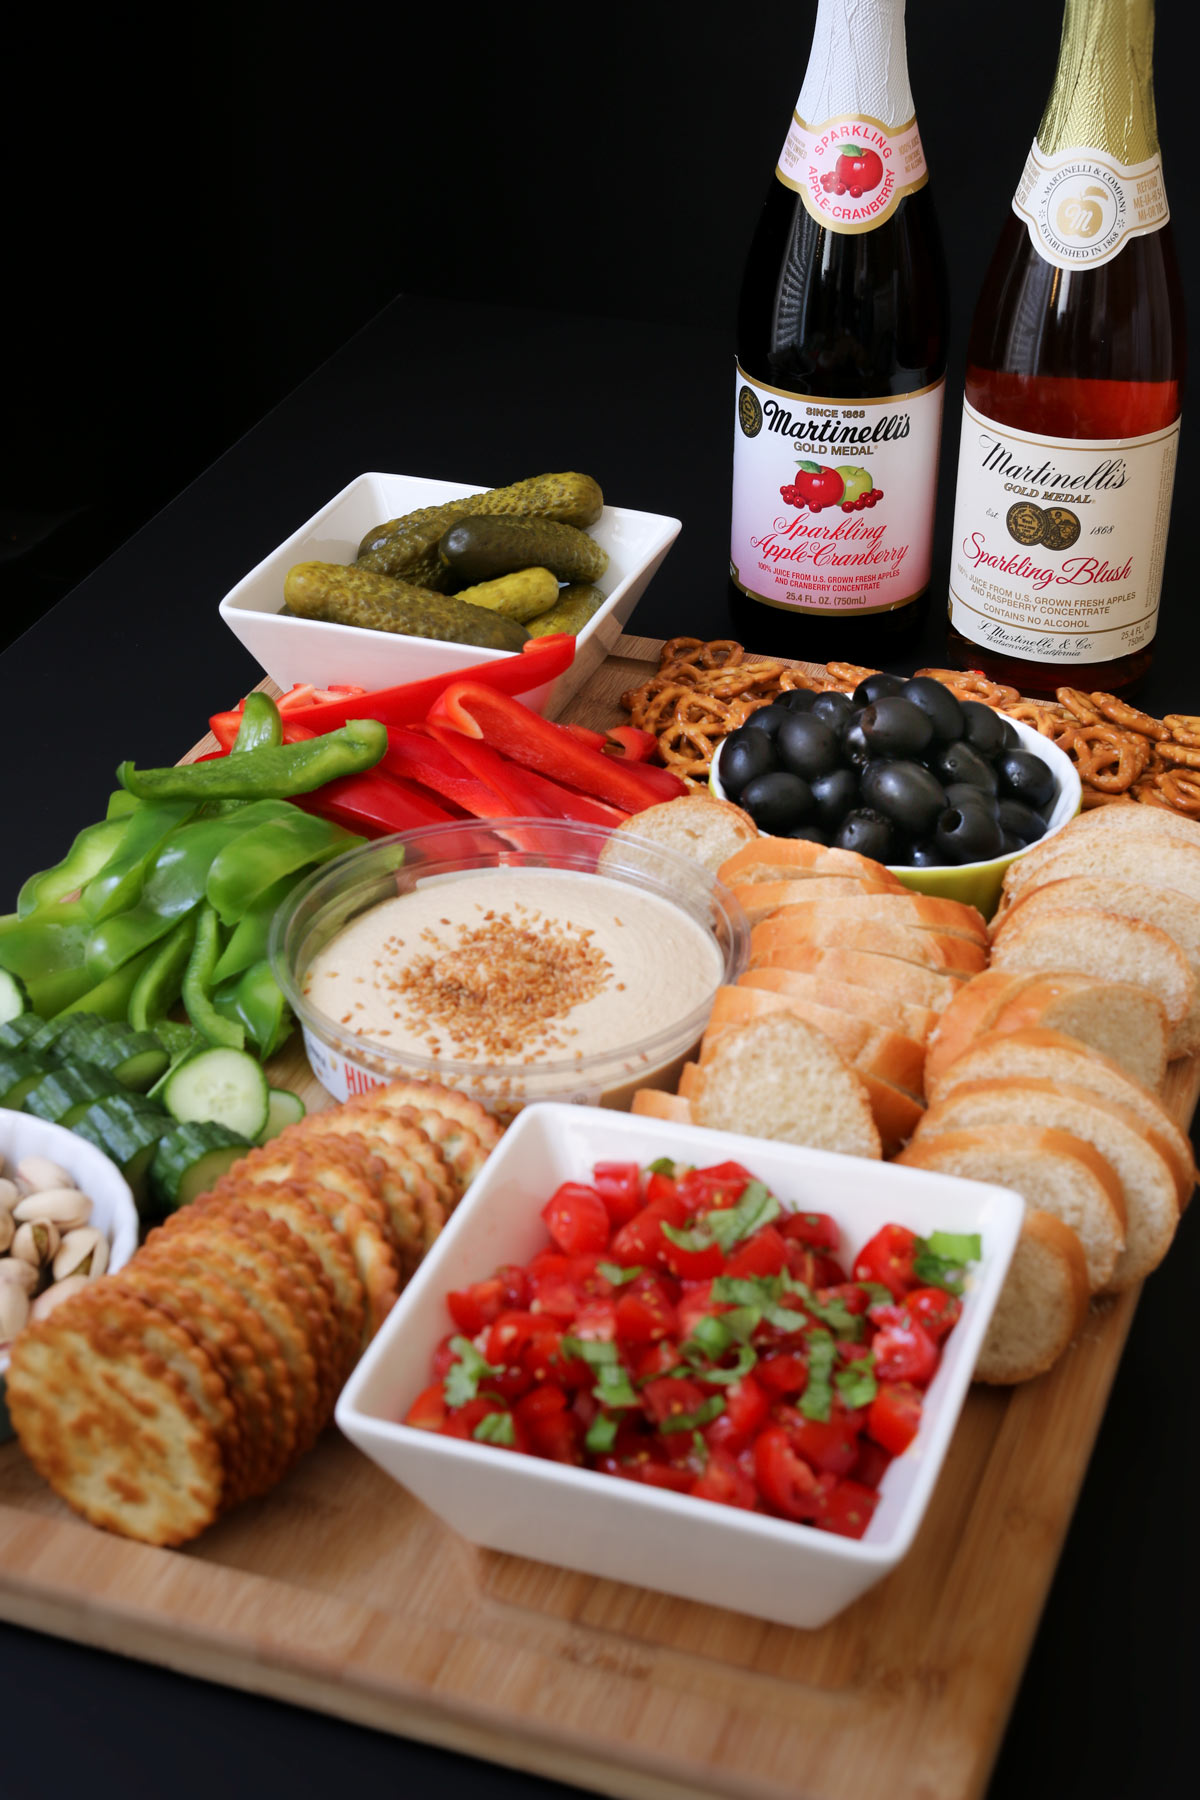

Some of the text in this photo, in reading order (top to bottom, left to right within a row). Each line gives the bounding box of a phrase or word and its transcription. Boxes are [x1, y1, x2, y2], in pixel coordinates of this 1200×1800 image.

[814, 125, 892, 159] SPARKLING
[808, 166, 896, 220] APPLE-CRANBERRY
[1044, 165, 1091, 196] MARTINELLI
[1094, 167, 1101, 175] &
[1103, 172, 1126, 214] COMPANY
[1040, 223, 1119, 258] ESTABLISHED IN 1868
[764, 400, 910, 444] Martinelli's
[806, 407, 866, 418] SINCE 1868
[794, 442, 874, 456] GOLD MEDAL
[979, 434, 1131, 490] Martinelli's
[1004, 482, 1040, 498] GOLD
[773, 512, 887, 548] Sparkling
[1090, 525, 1115, 536] 1868
[750, 534, 910, 570] Apple-Cranberry
[962, 532, 1134, 590] Sparkling Blush
[758, 562, 900, 584] 100% JUICE FROM U.S. GROWN FRESH APPLES
[774, 576, 880, 592] AND CRANBERRY CONCENTRATE
[786, 592, 866, 606] 25.4 FL. OZ. (750mL)
[969, 574, 988, 589] JUICE
[989, 584, 1012, 598] FROM
[1015, 592, 1032, 603] U.S.
[1034, 596, 1072, 608] GROWN
[1074, 600, 1104, 608] FRESH
[1106, 592, 1136, 605] APPLES
[970, 584, 1110, 616] AND RASPBERRY CONCENTRATE
[984, 602, 1090, 628] CONTAINS NO ALCOHOL
[986, 634, 1080, 657] Watsonville, California
[991, 624, 1054, 648] Martinelli
[1058, 638, 1071, 650] &
[1075, 638, 1094, 650] Co.
